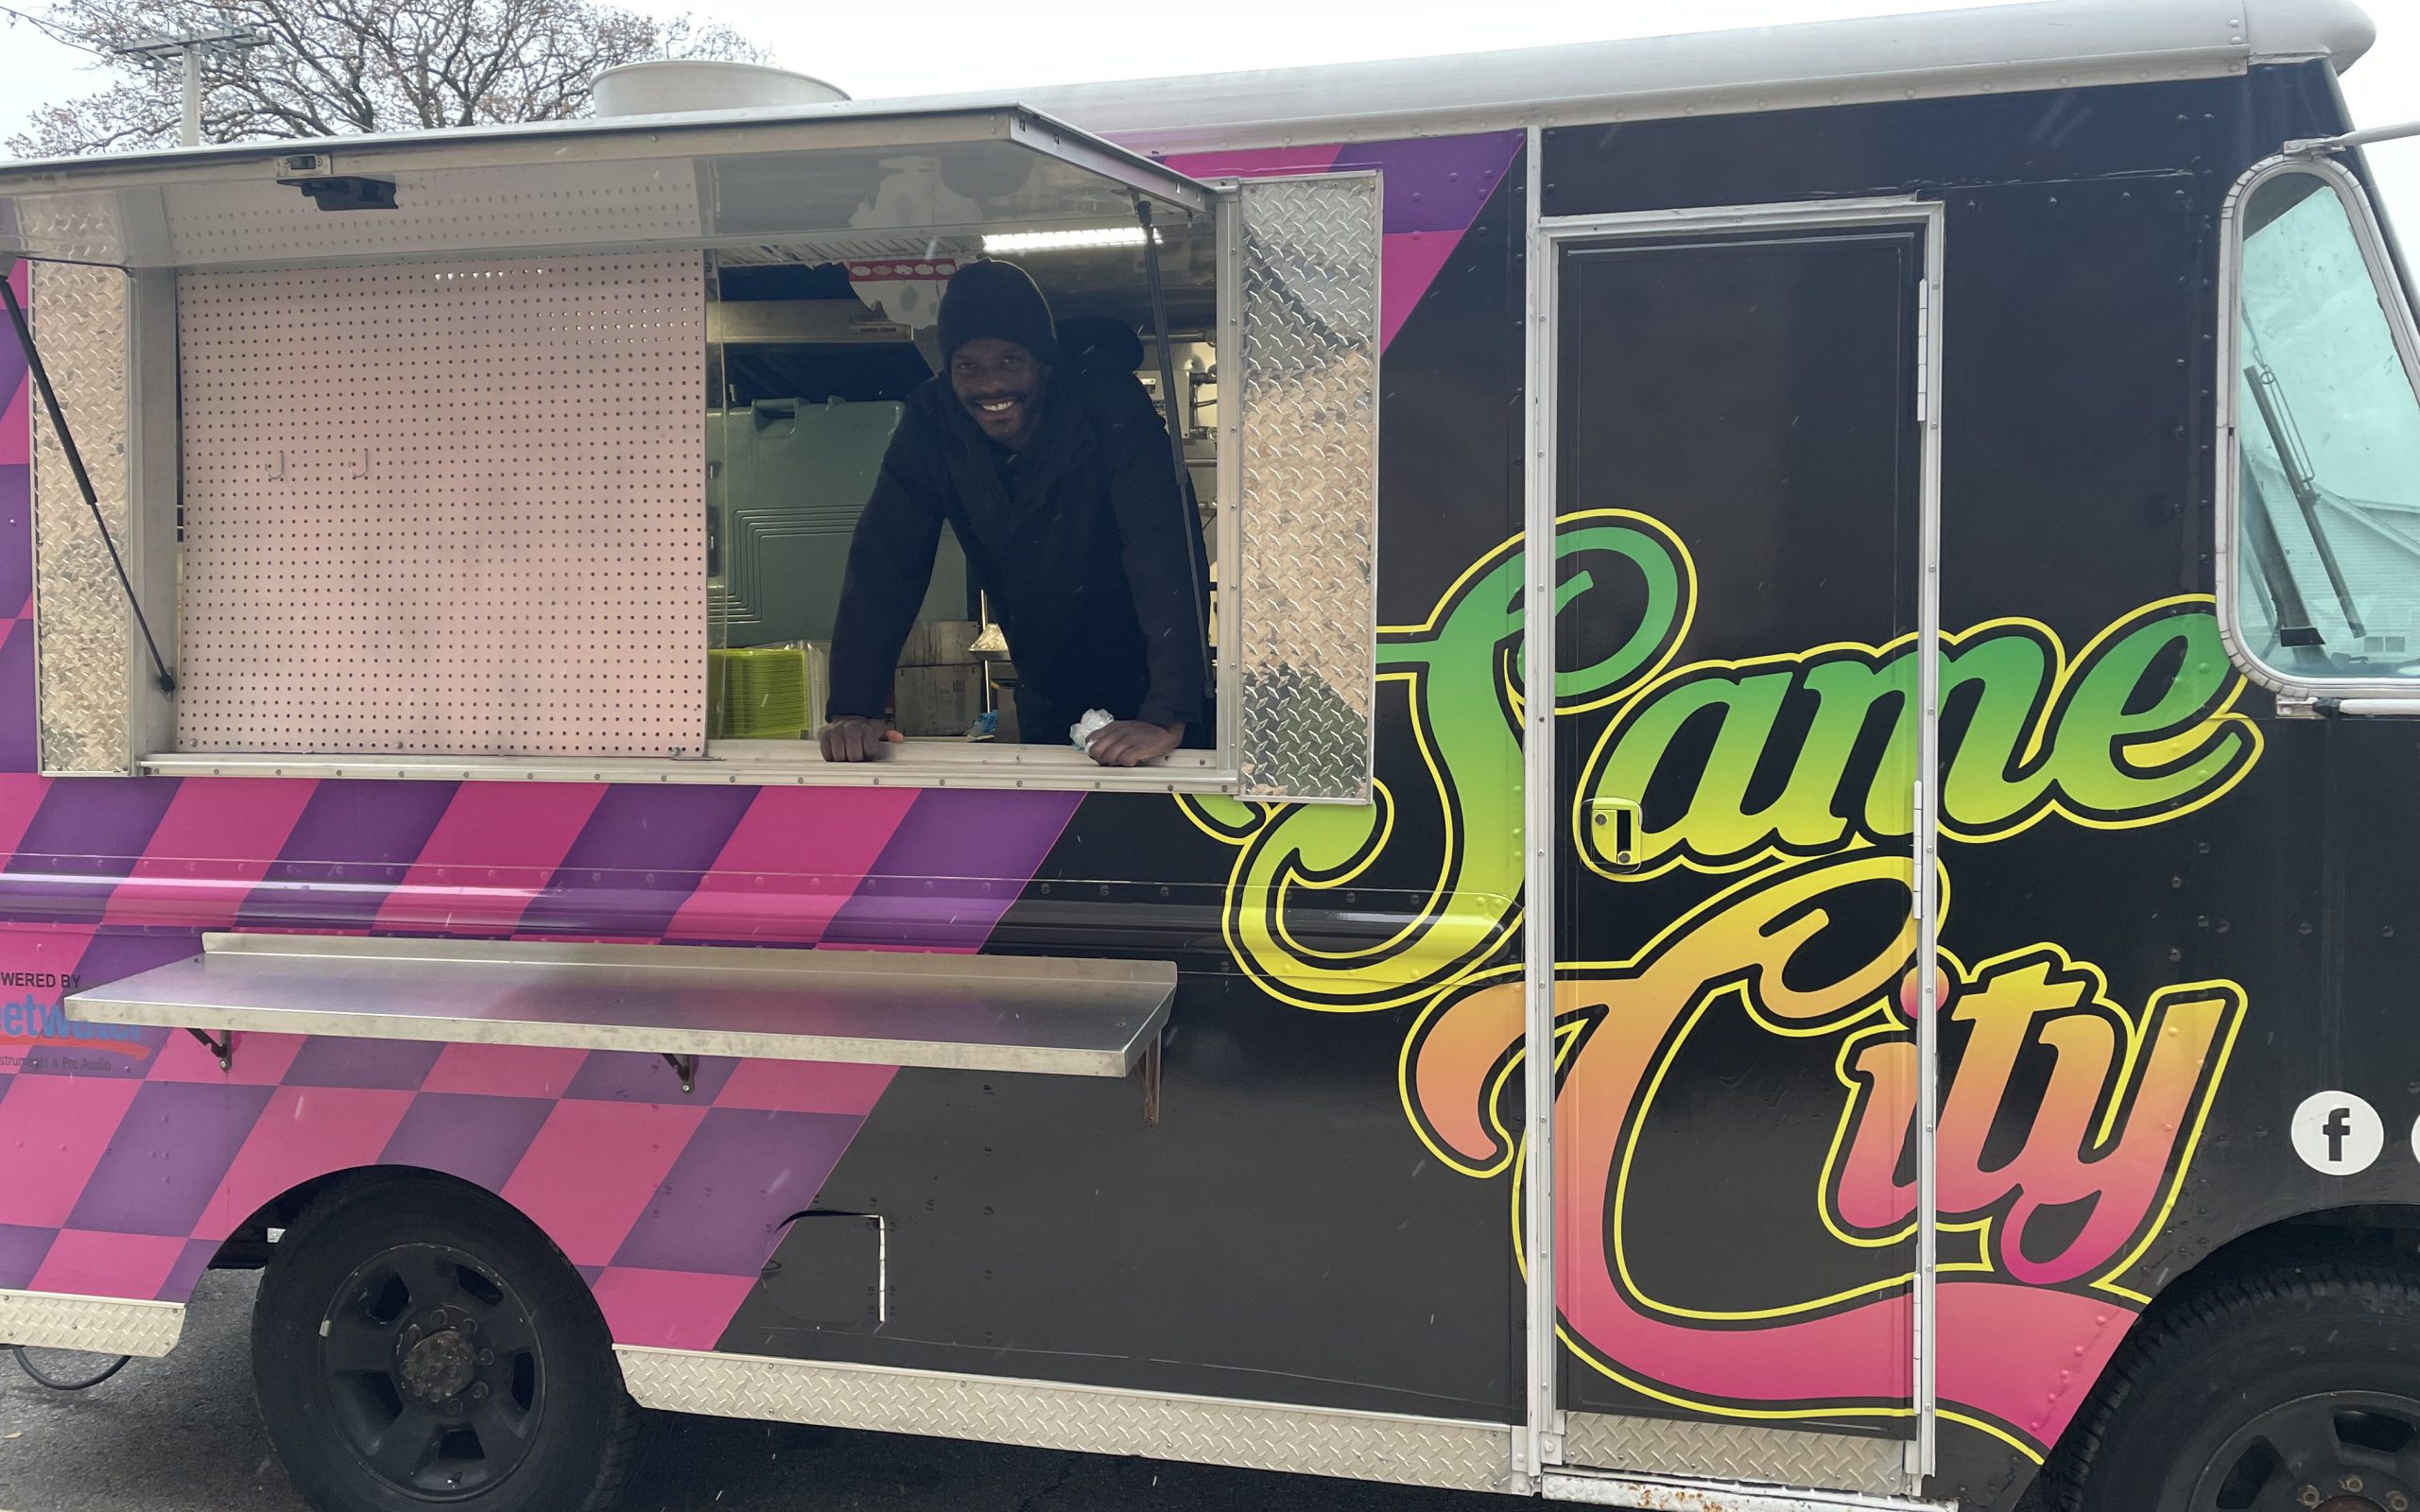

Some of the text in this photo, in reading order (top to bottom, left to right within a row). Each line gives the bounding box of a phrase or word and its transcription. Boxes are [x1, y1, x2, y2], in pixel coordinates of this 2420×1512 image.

[60, 974, 81, 988] BY
[62, 1057, 78, 1070] Pro
[81, 1057, 112, 1072] Audio
[1400, 855, 2248, 1460] City
